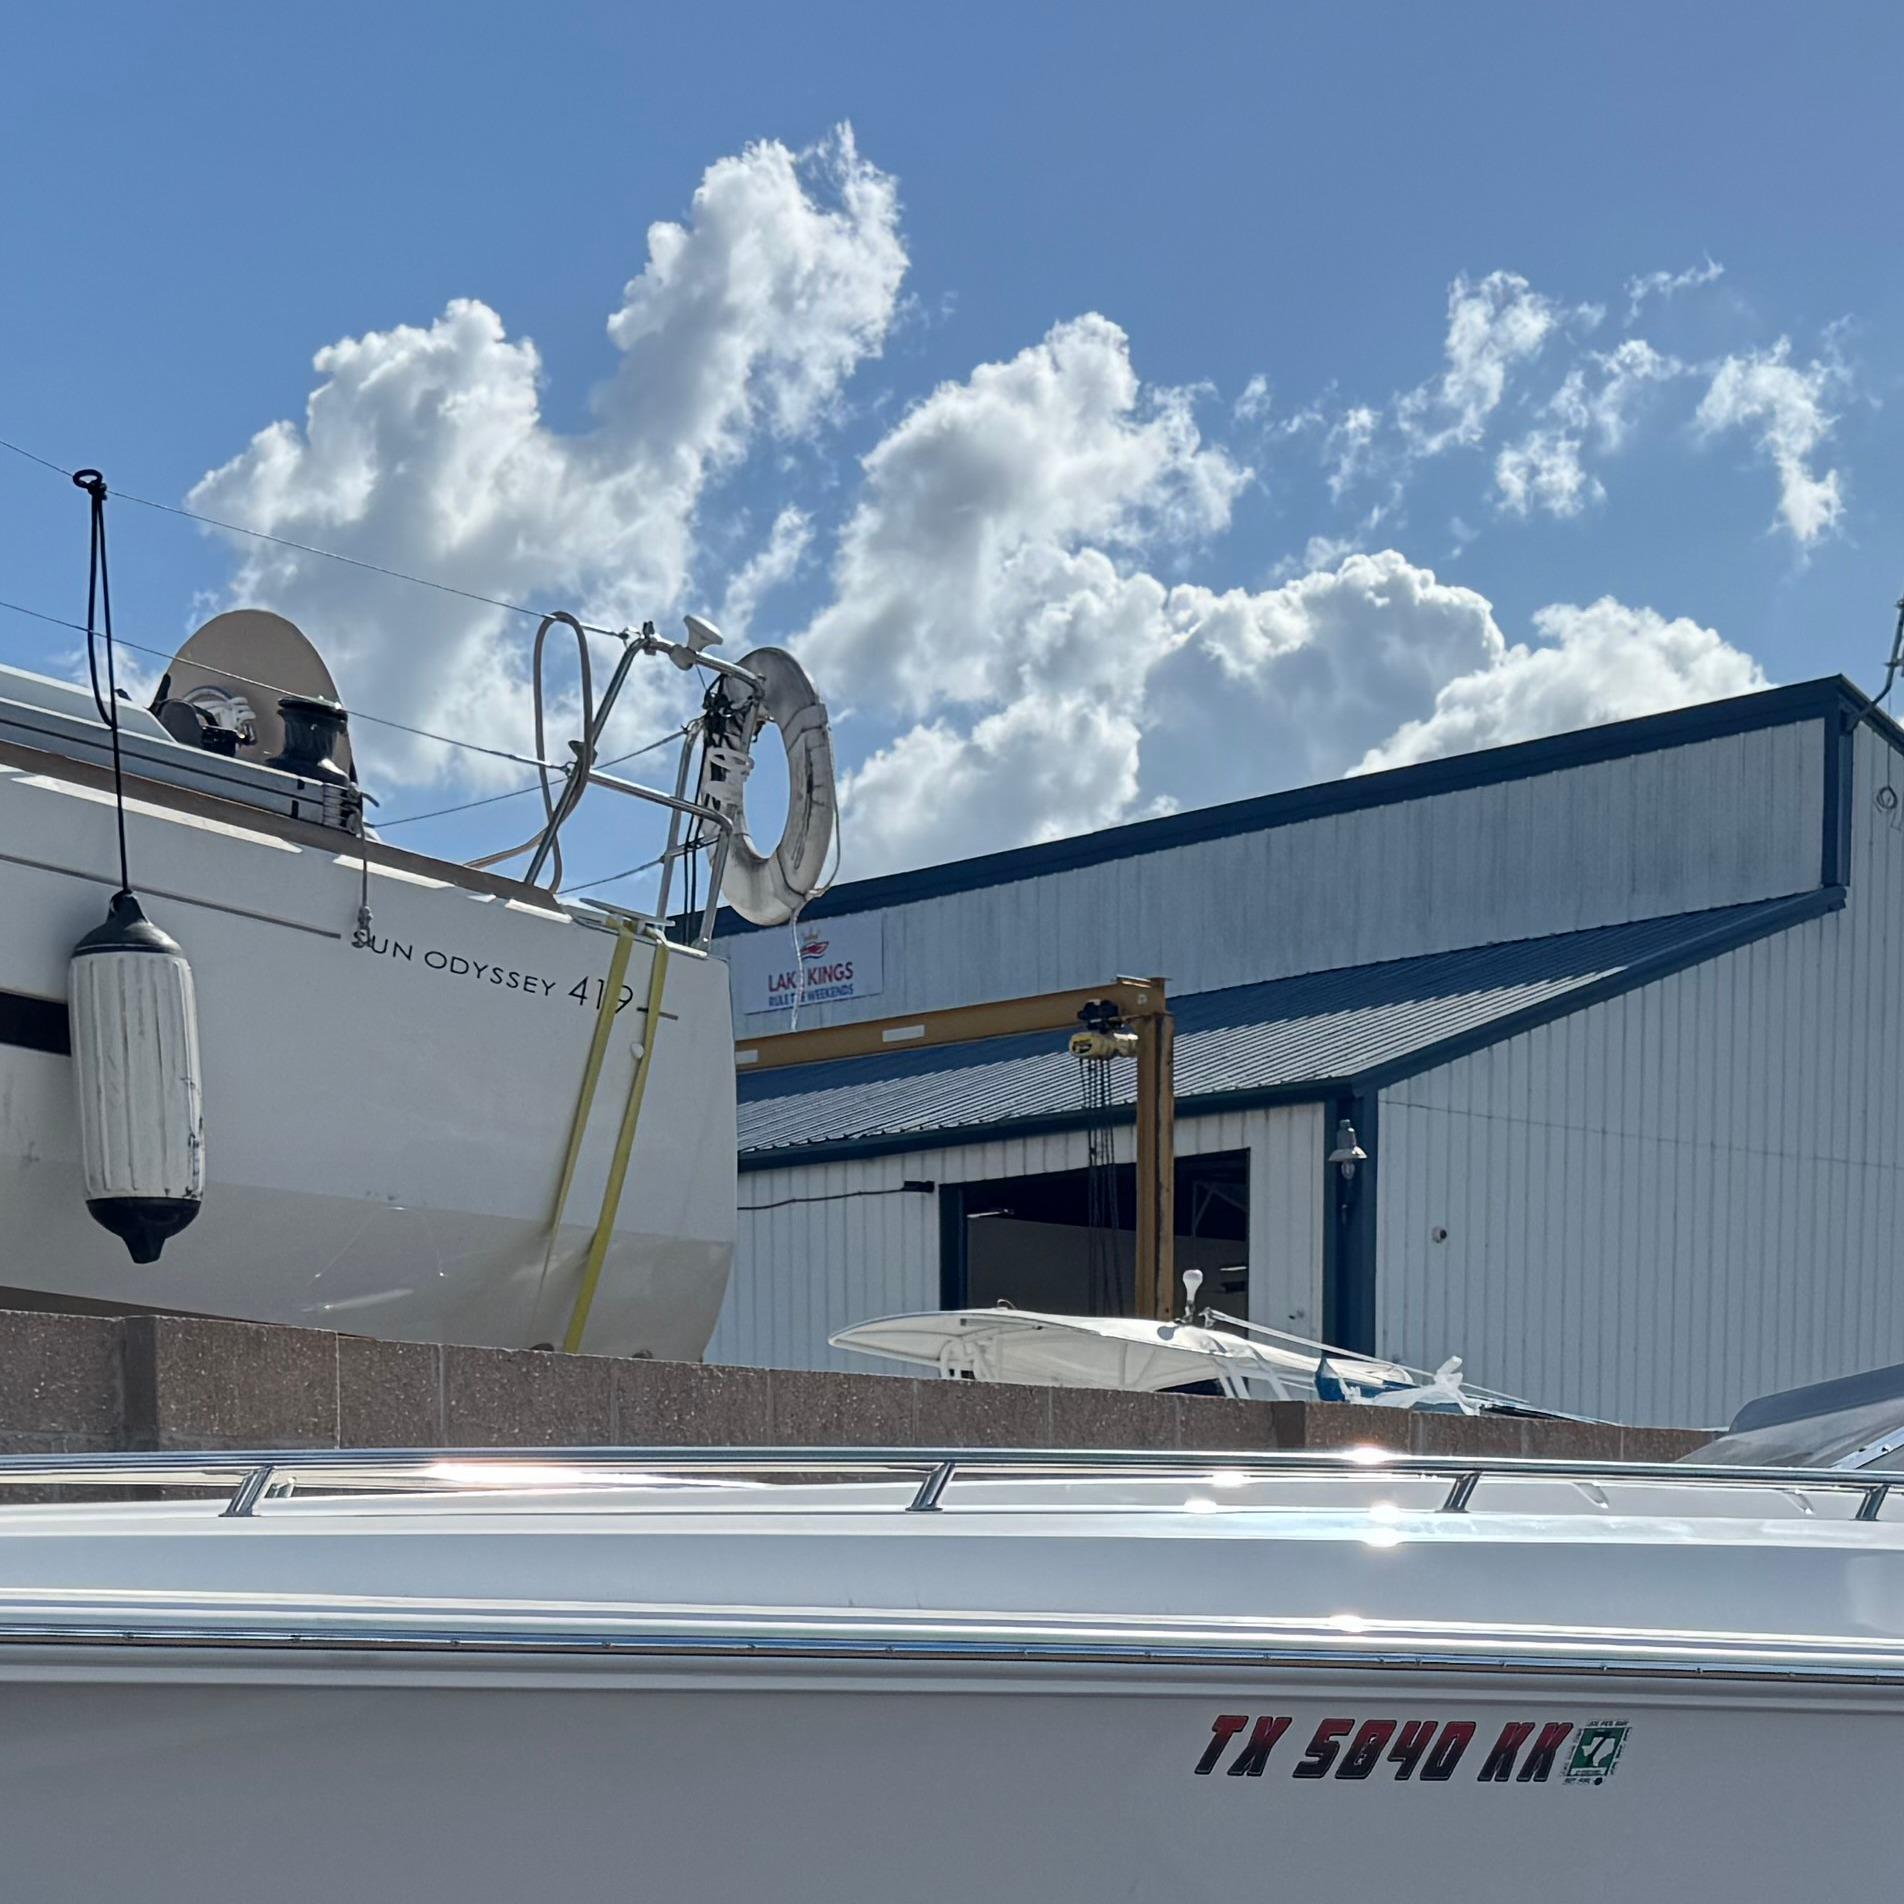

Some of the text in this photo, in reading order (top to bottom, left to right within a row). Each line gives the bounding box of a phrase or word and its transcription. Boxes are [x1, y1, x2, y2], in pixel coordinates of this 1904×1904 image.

[351, 930, 633, 1014] SUN ODYSSEY 419
[768, 961, 853, 992] LAK KINGS
[1194, 1715, 1292, 1777] TX
[1292, 1718, 1476, 1781] 5840
[1477, 1722, 1574, 1782] KK
